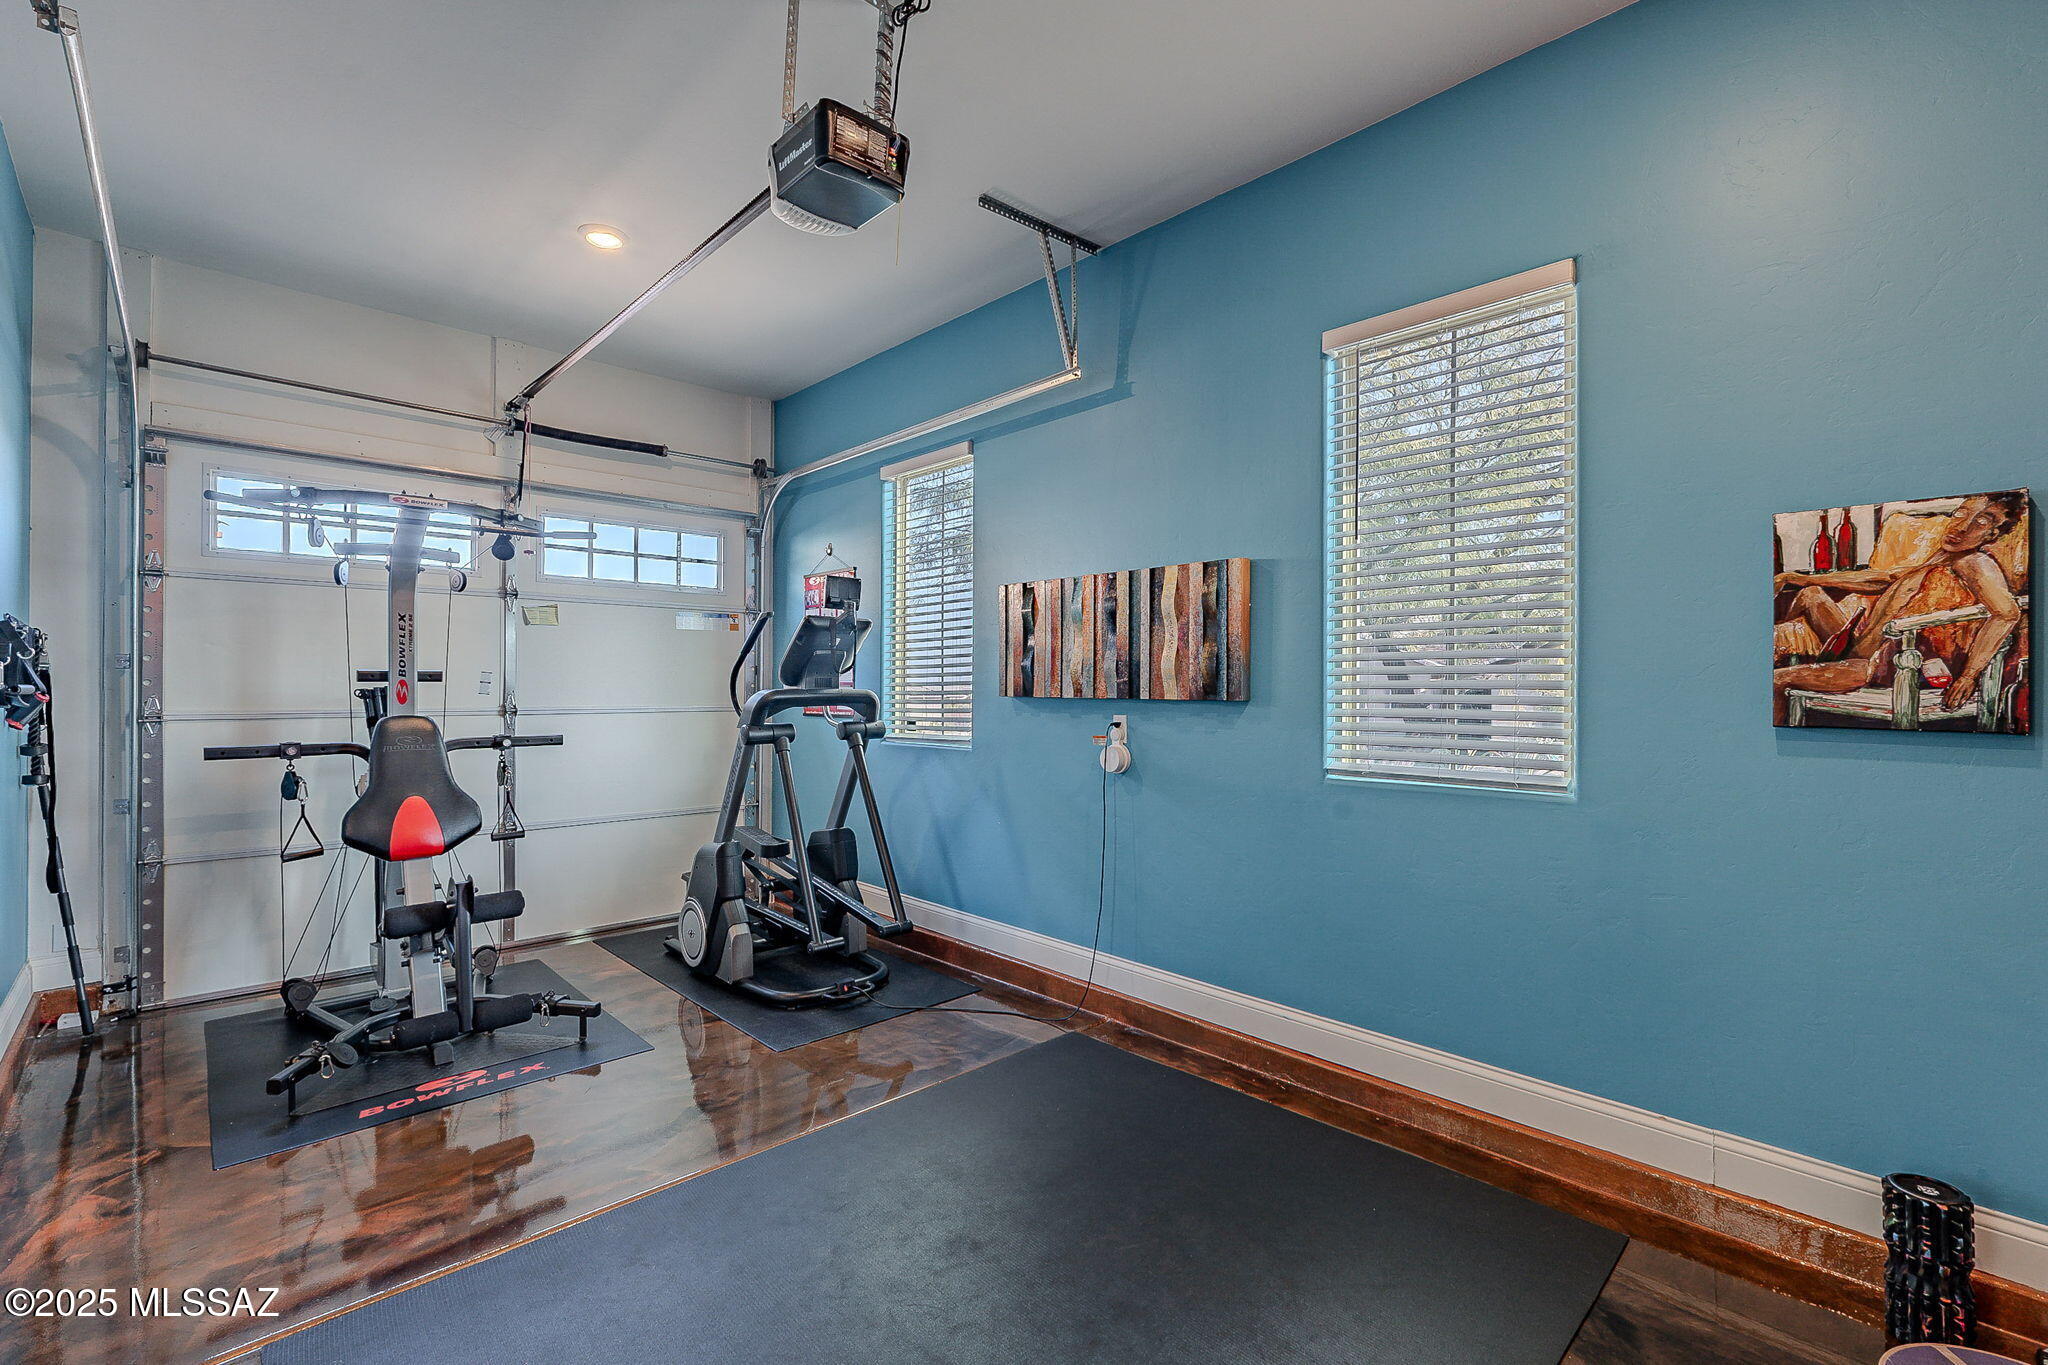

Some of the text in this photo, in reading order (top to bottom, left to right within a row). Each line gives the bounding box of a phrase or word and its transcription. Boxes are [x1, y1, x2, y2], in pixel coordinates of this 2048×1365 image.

[779, 138, 812, 171] LiftMaster
[410, 499, 444, 507] BOWFLEX
[398, 612, 406, 678] BOWFLEX
[358, 1061, 545, 1118] BOWFLEX
